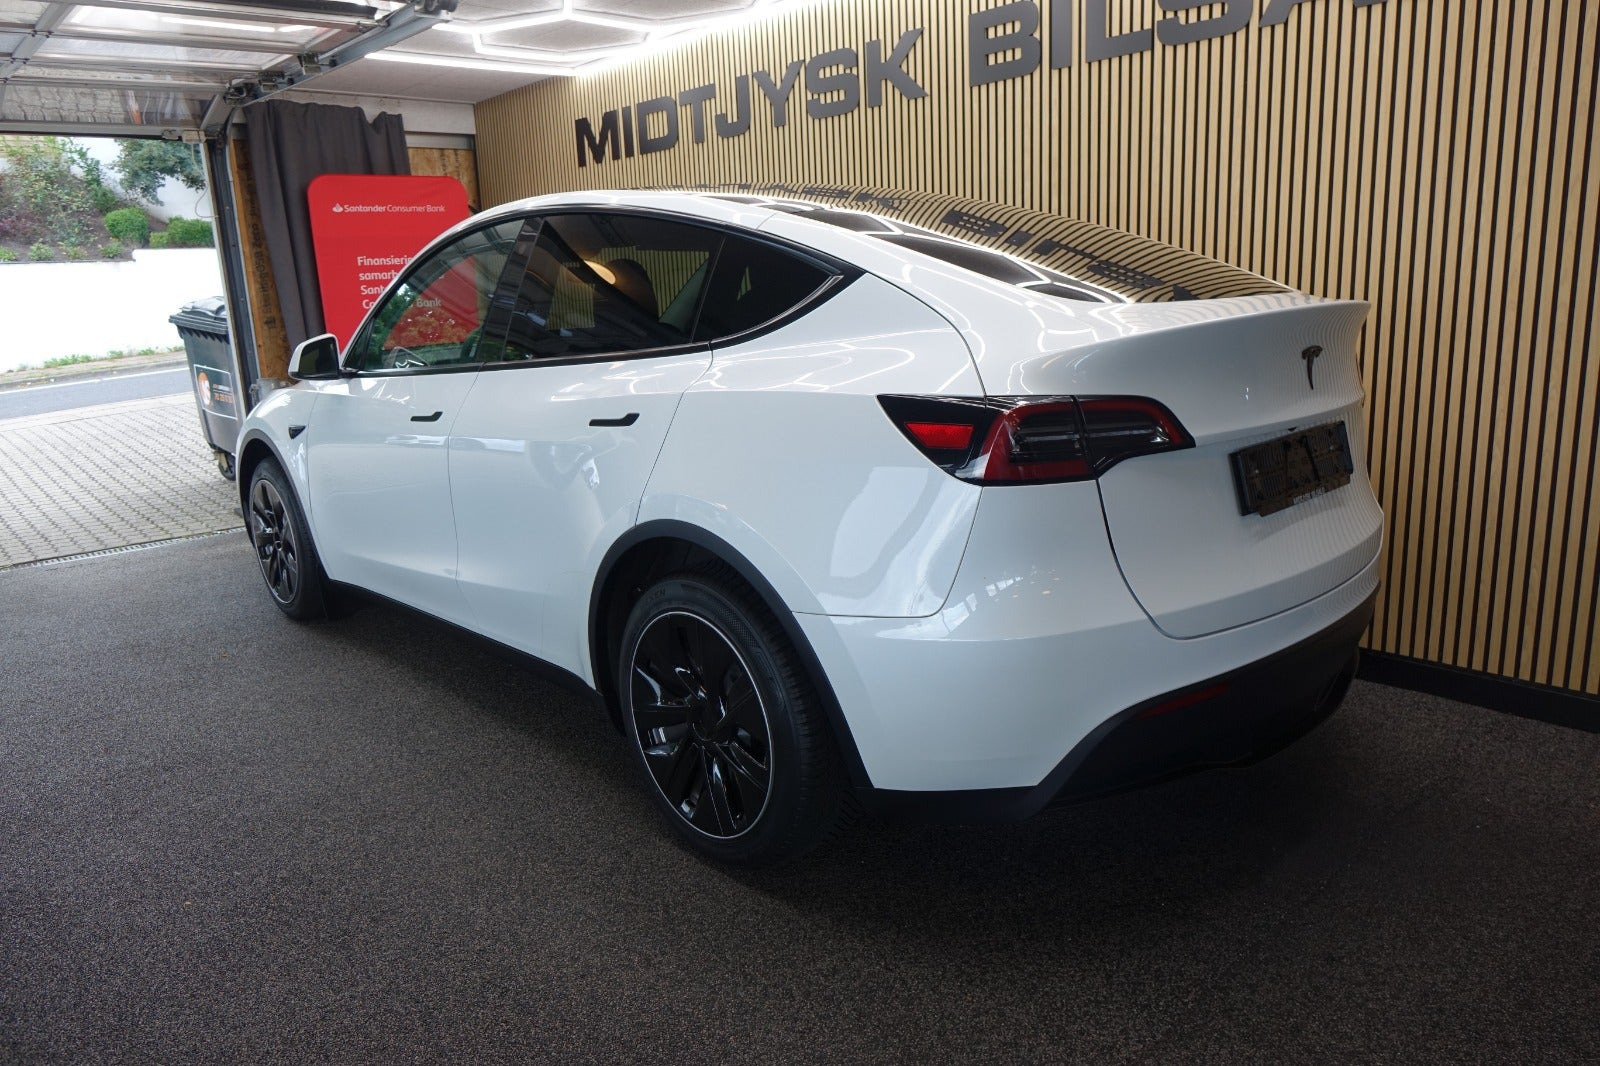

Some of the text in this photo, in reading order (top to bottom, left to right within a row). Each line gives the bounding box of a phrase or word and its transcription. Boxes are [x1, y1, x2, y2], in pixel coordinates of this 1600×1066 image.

[575, 27, 929, 167] MIDTJYSK
[344, 204, 445, 213] Santander Consumer Bank
[416, 298, 441, 308] Bank
